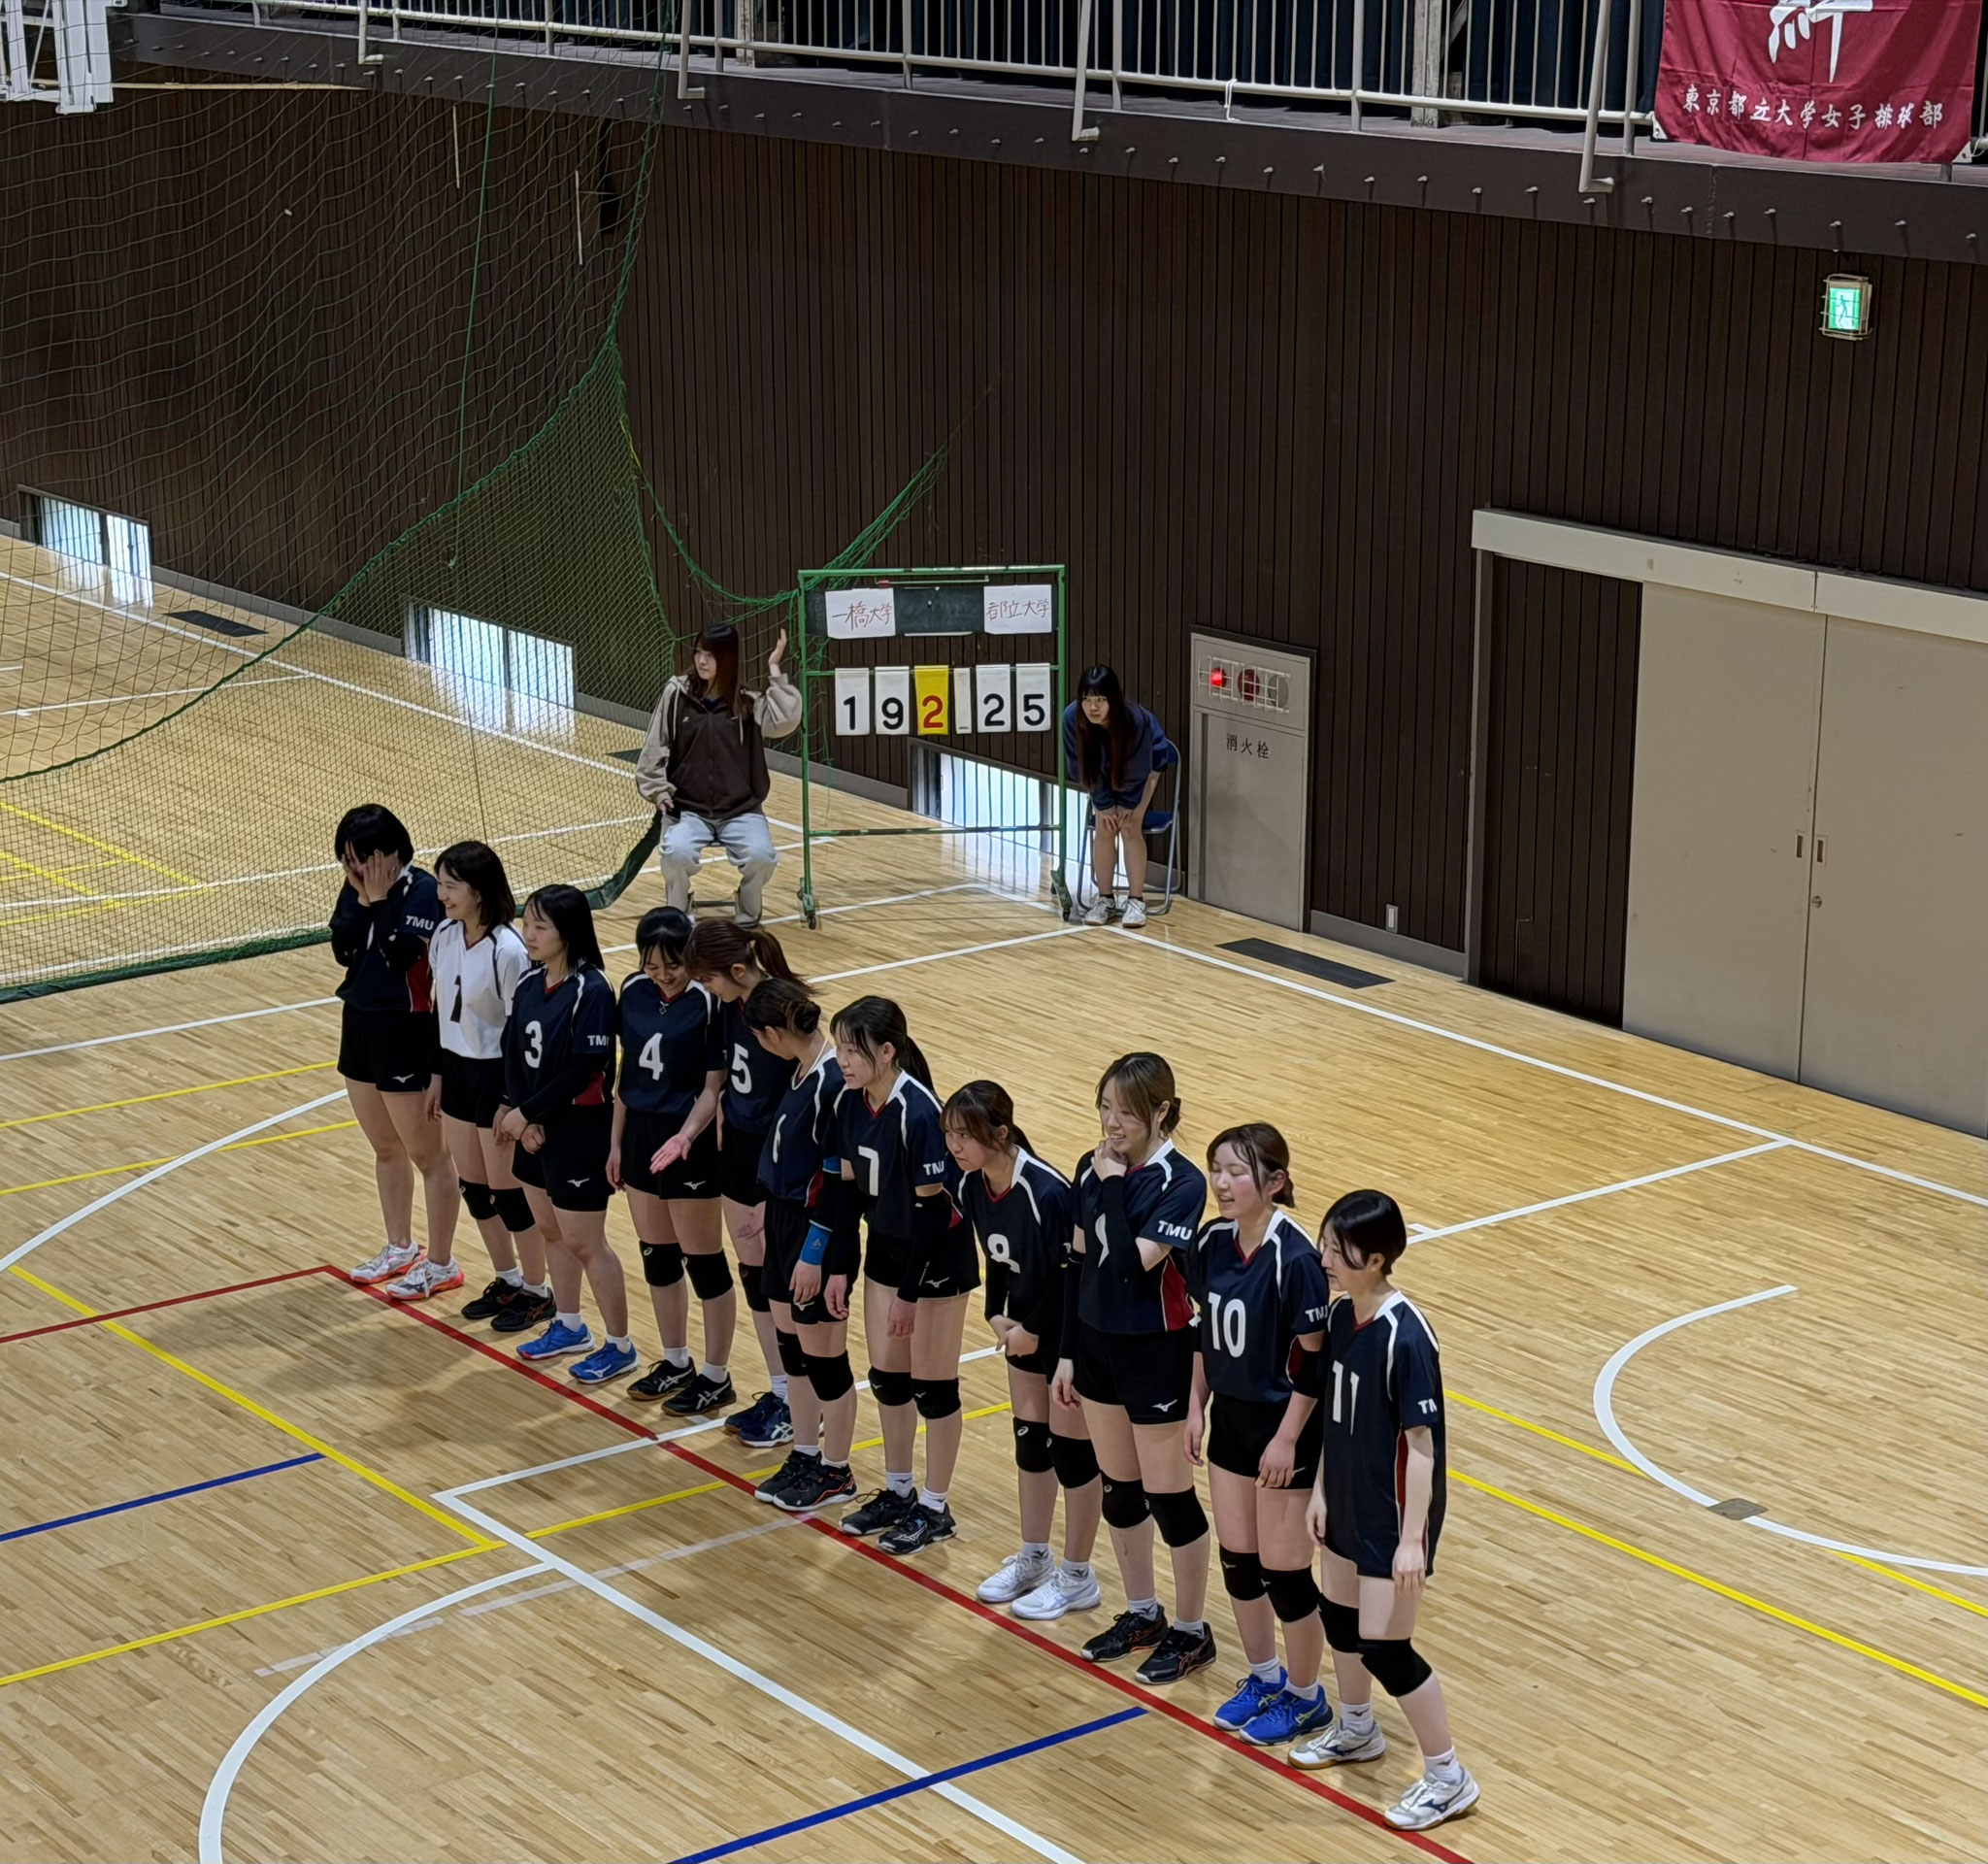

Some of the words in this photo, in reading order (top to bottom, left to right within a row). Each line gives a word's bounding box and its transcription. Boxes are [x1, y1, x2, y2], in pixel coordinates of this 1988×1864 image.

[832, 600, 892, 630] 一橋大学
[985, 598, 1049, 620] 都立大学
[1226, 733, 1270, 759] 消火栓
[406, 915, 435, 931] TMU
[524, 1020, 543, 1068] 3
[587, 1034, 610, 1047] TM
[639, 1032, 664, 1081] 4
[731, 1044, 752, 1094] 5
[858, 1146, 879, 1196] 7
[1157, 1220, 1193, 1241] TMU
[1208, 1292, 1245, 1358] 10
[1333, 1361, 1360, 1436] 11
[1417, 1398, 1438, 1414] TM
